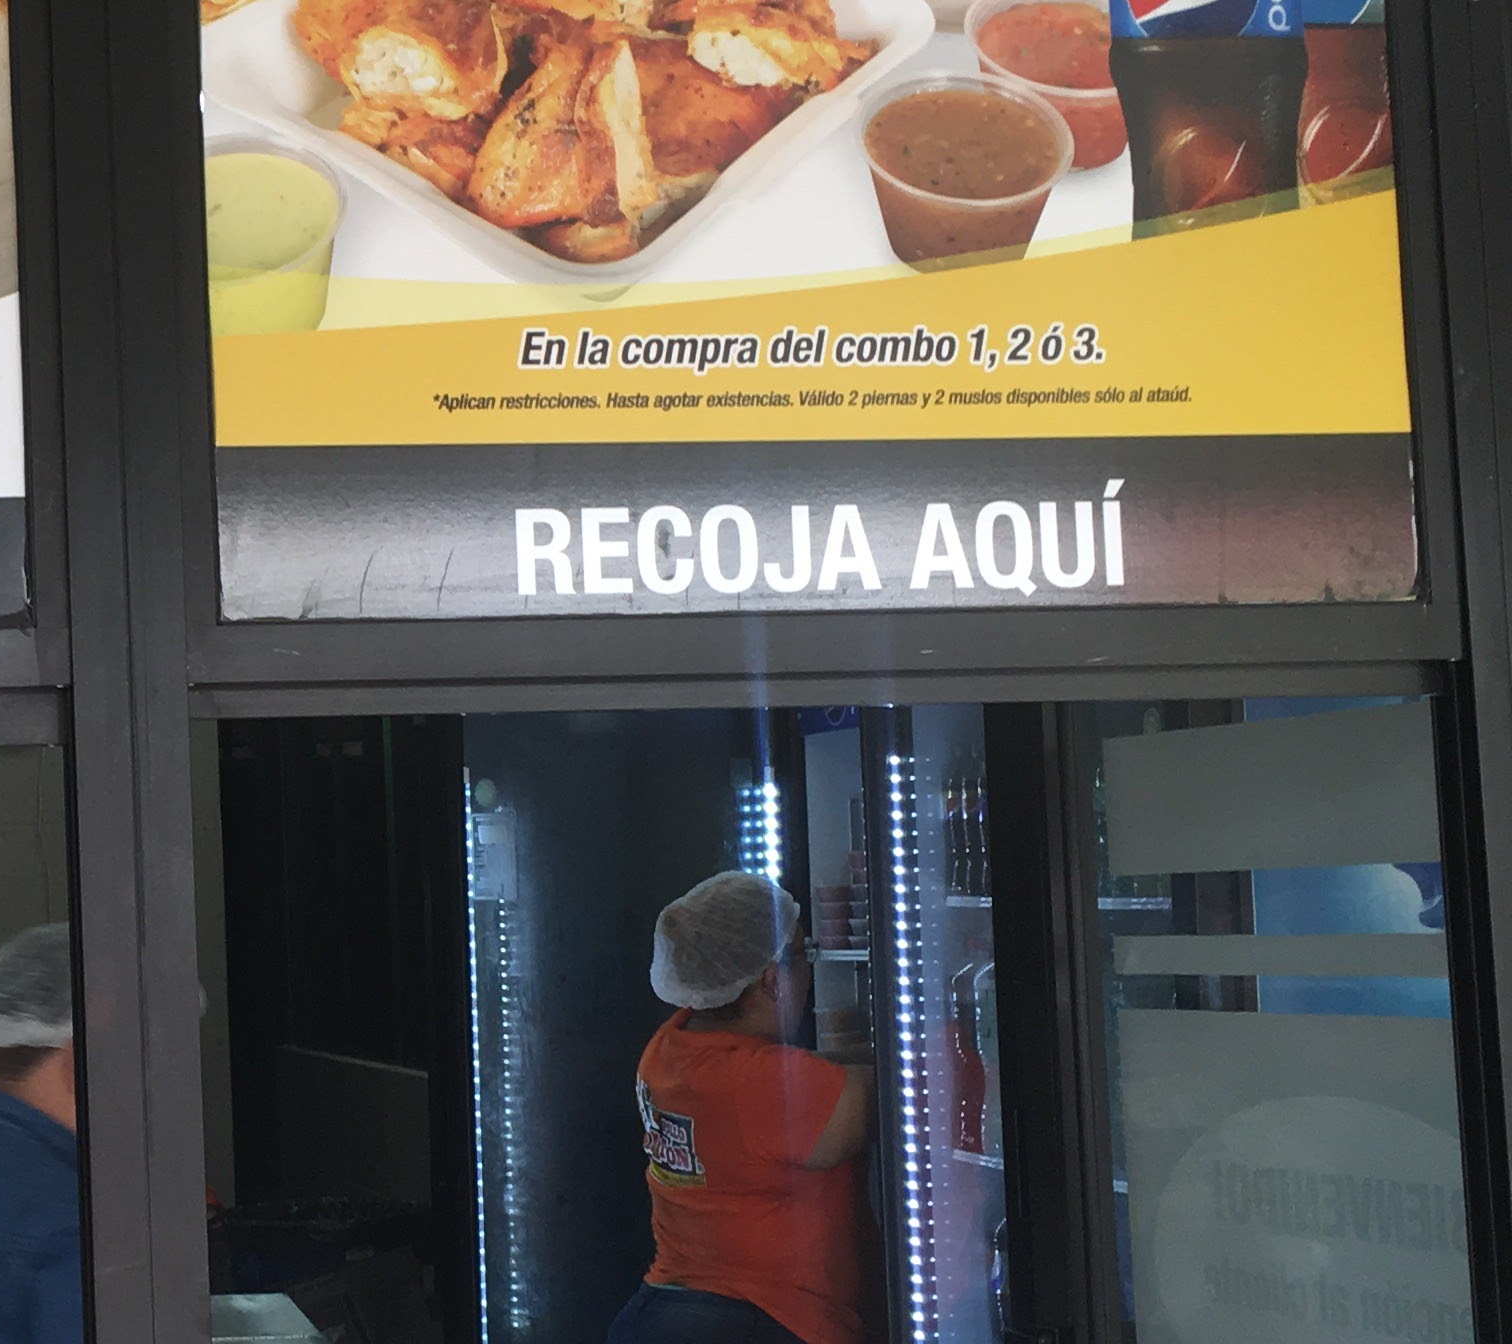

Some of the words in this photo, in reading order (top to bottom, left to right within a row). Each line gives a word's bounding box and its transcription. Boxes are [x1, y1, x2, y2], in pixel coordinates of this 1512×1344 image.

[519, 329, 566, 367] En
[577, 328, 609, 367] la
[617, 336, 759, 374] compra
[769, 326, 828, 366] del
[834, 327, 956, 365] combo
[967, 327, 999, 370] 1,
[1003, 327, 1031, 363] 2
[1038, 325, 1065, 362] ó
[1071, 325, 1106, 363] 3.
[500, 391, 601, 409] restricciones.
[606, 392, 649, 409] Hasta
[653, 392, 703, 411] agotar
[706, 390, 794, 409] existencias.
[799, 388, 845, 407] Válido
[848, 391, 860, 407] 2
[863, 390, 918, 411] piernas
[921, 394, 932, 410] y
[935, 390, 946, 406] 2
[949, 388, 1001, 406] muslos
[1006, 387, 1090, 410] disponibles
[1094, 386, 1125, 405] sólo
[1129, 386, 1144, 404] al
[1147, 385, 1193, 404] ataúd.
[514, 502, 881, 596] RECOJA
[910, 478, 1126, 598] AQUÍ
